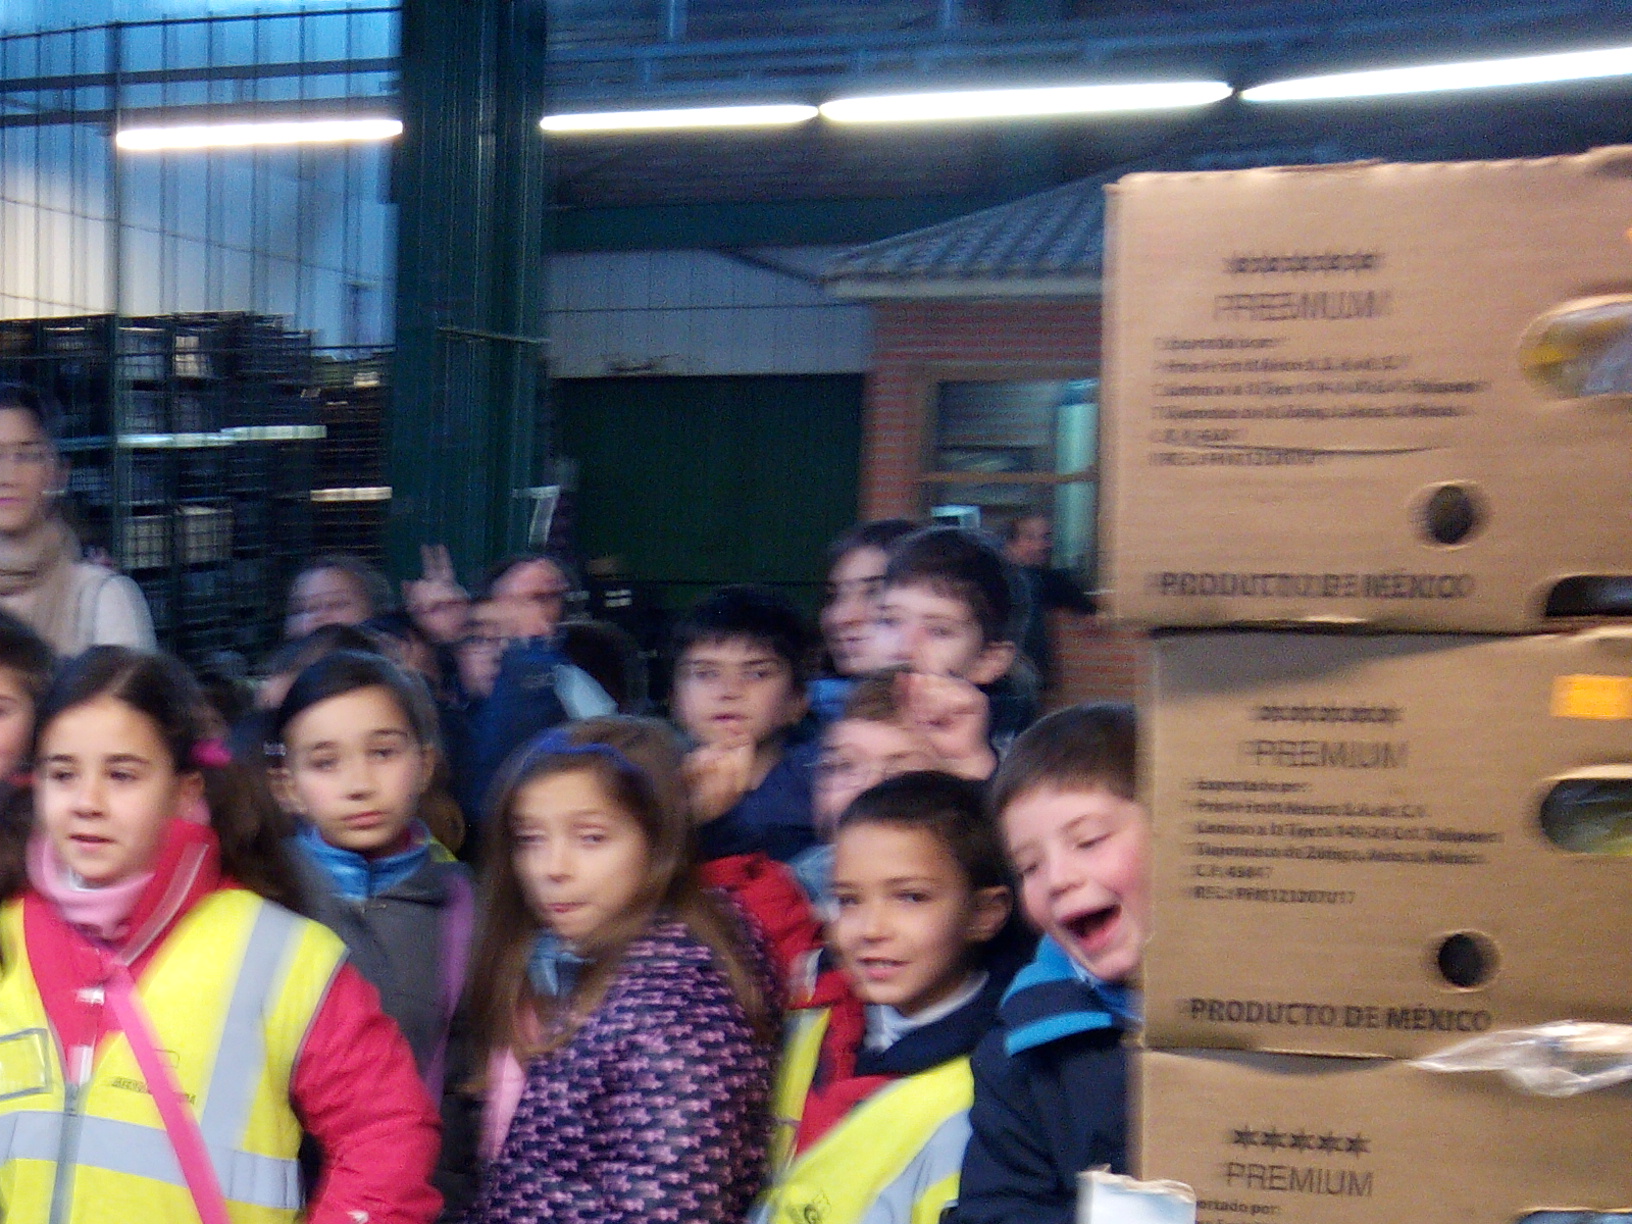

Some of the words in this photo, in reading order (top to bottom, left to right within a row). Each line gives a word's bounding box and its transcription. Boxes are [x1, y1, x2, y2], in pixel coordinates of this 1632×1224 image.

[1214, 290, 1394, 321] PREMIUM
[1147, 571, 1317, 599] PRODUCTO
[1320, 571, 1360, 598] DE
[1241, 739, 1409, 768] PREMIUM
[1189, 998, 1337, 1026] PRODUCTO
[1342, 1003, 1381, 1029] DE
[1386, 1003, 1492, 1032] MÉXICO
[1227, 1161, 1373, 1197] PREMIUM
